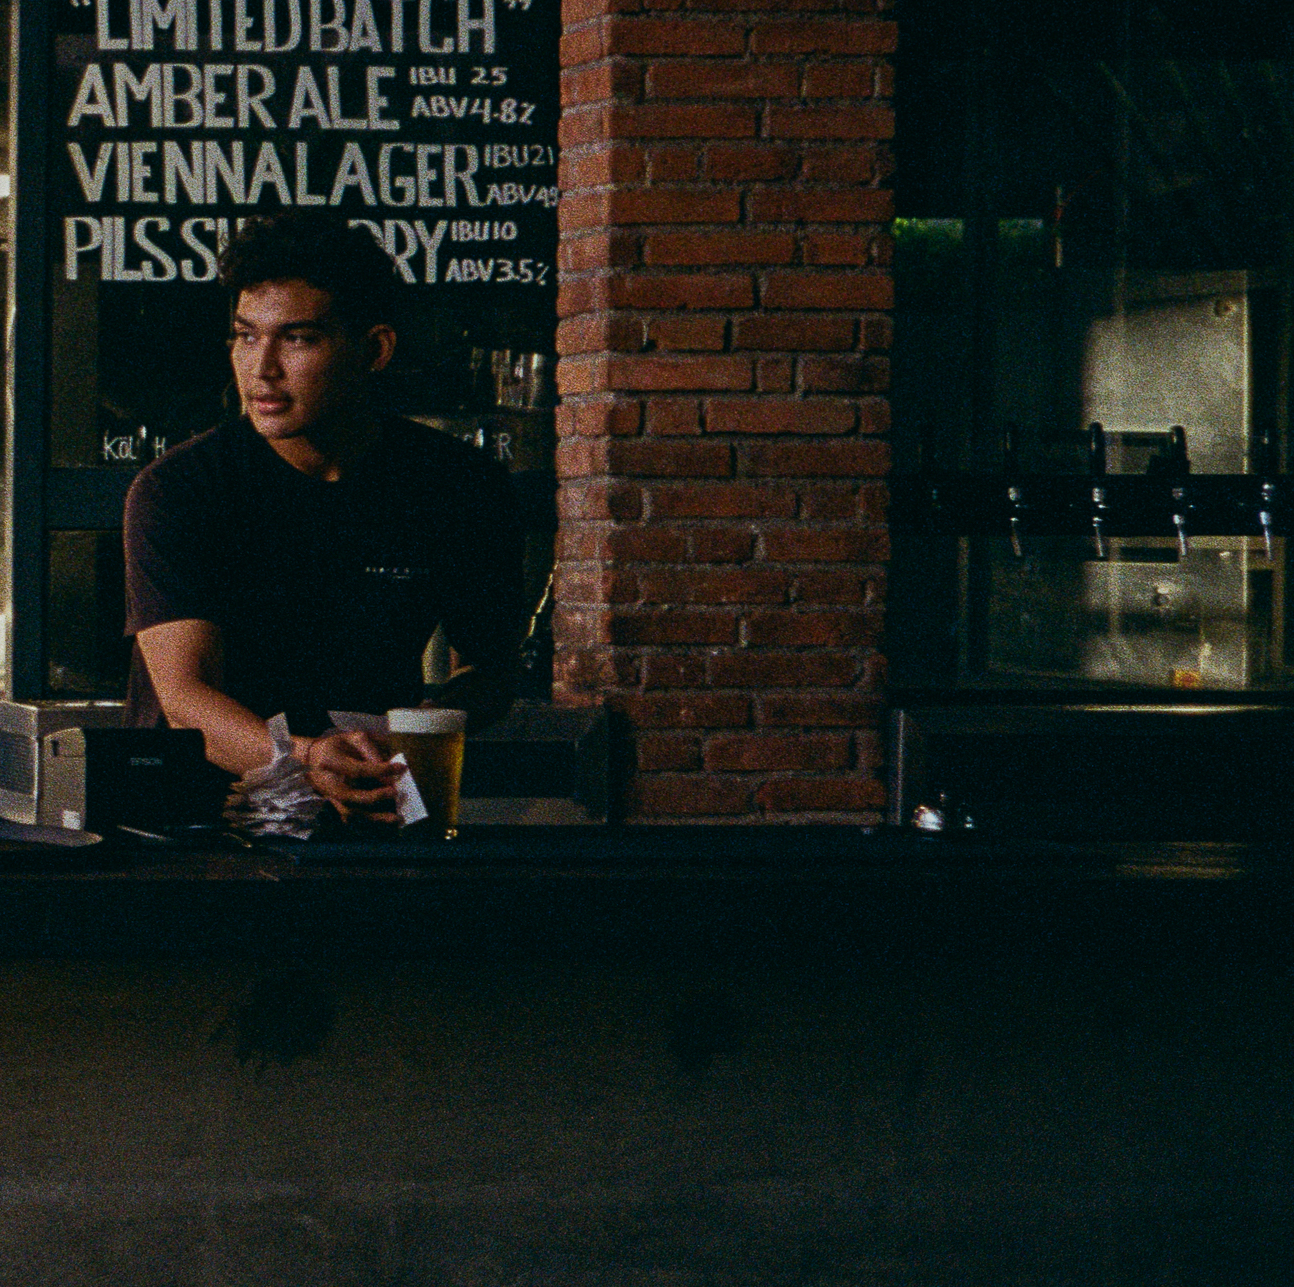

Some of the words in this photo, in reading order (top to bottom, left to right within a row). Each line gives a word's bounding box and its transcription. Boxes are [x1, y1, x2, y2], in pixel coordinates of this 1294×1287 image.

[66, 63, 276, 129] AMBER
[287, 66, 400, 131] ALE
[409, 66, 457, 86] IBU
[470, 66, 508, 86] 25
